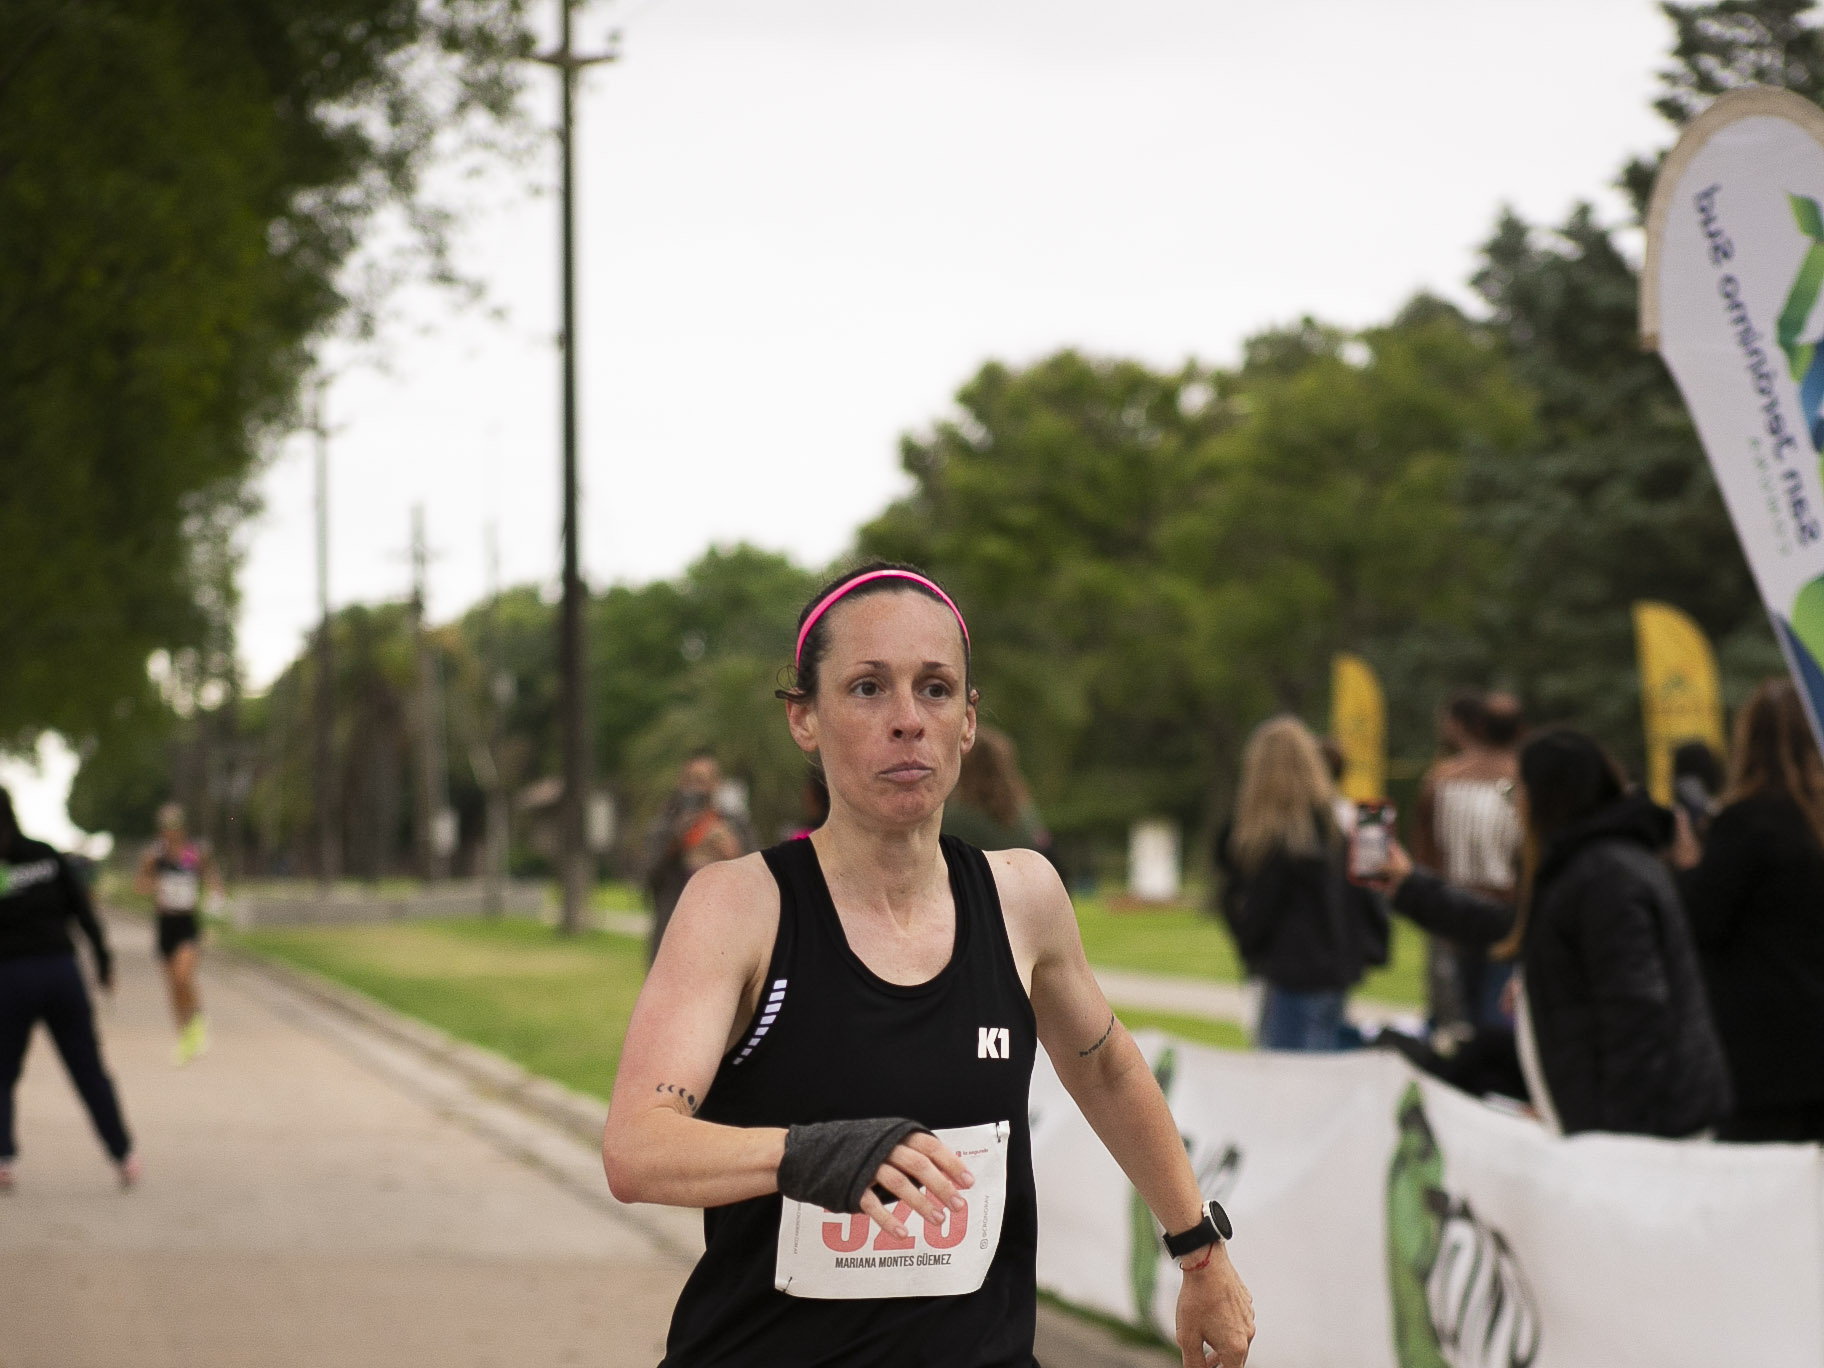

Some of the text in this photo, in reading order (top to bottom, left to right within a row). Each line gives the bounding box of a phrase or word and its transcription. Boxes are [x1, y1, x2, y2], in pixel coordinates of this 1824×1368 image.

[978, 1027, 1010, 1059] K1
[835, 1252, 951, 1268] MARIANA MONTES GÜEMEZ
